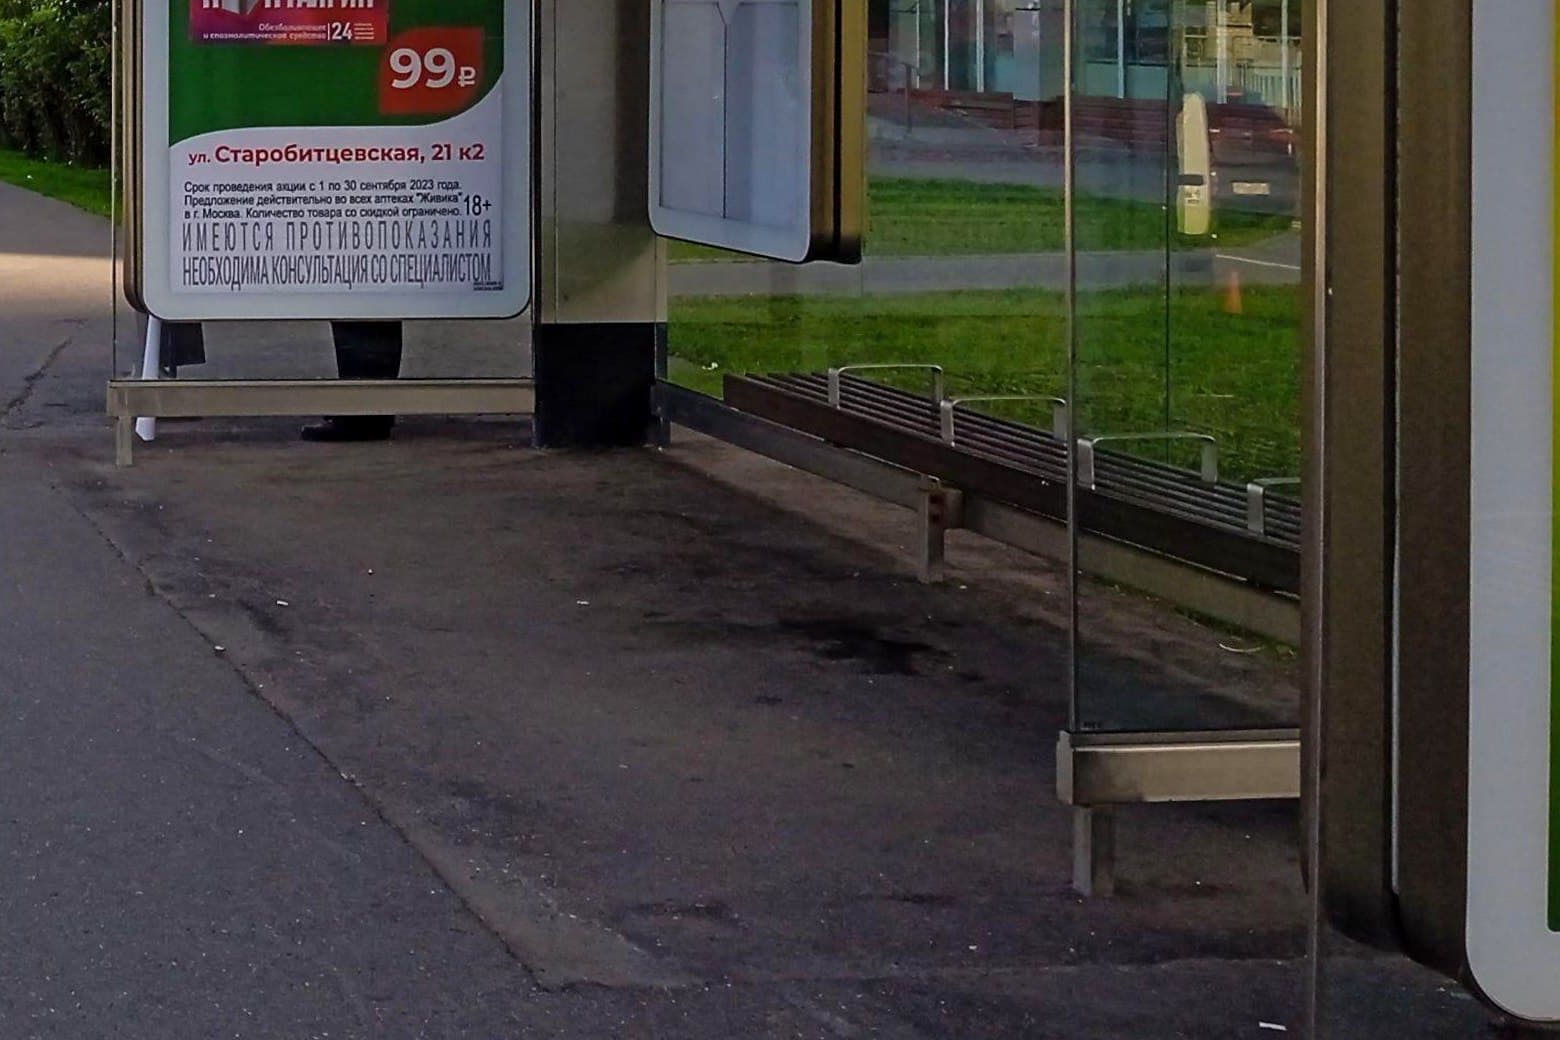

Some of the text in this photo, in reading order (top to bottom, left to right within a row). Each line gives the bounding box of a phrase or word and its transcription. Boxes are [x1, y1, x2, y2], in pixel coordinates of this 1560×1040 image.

[331, 21, 353, 40] 24
[188, 144, 485, 167] ул. Старобитцевская, 21 к2
[184, 181, 210, 194] Срок
[213, 182, 273, 194] проведения
[276, 182, 306, 193] акции
[309, 183, 316, 192] с
[328, 182, 341, 191] по
[344, 180, 357, 191] 30
[360, 179, 407, 192] сентября
[410, 179, 434, 190] 2023
[437, 180, 462, 191] года.
[184, 194, 254, 207] Предложение
[256, 194, 332, 206] действительно
[335, 195, 347, 204] во
[349, 194, 372, 205] всех
[374, 194, 413, 204] аптеках
[464, 195, 492, 216] 18+
[184, 210, 191, 219] в
[202, 208, 243, 219] Москва.
[246, 208, 305, 219] Количество
[308, 209, 342, 220] товара
[345, 208, 357, 218] со
[360, 207, 399, 219] скидкой
[402, 207, 462, 219] ограничено.
[183, 219, 491, 251] ИМЕЮТСЯ ПРОТИВОПОКАЗАНИЯ
[183, 253, 491, 291] НЕОБХОДИМА КОНСУЛЬТАЦИЯ СО СПЕЦИАЛИСТОМ
